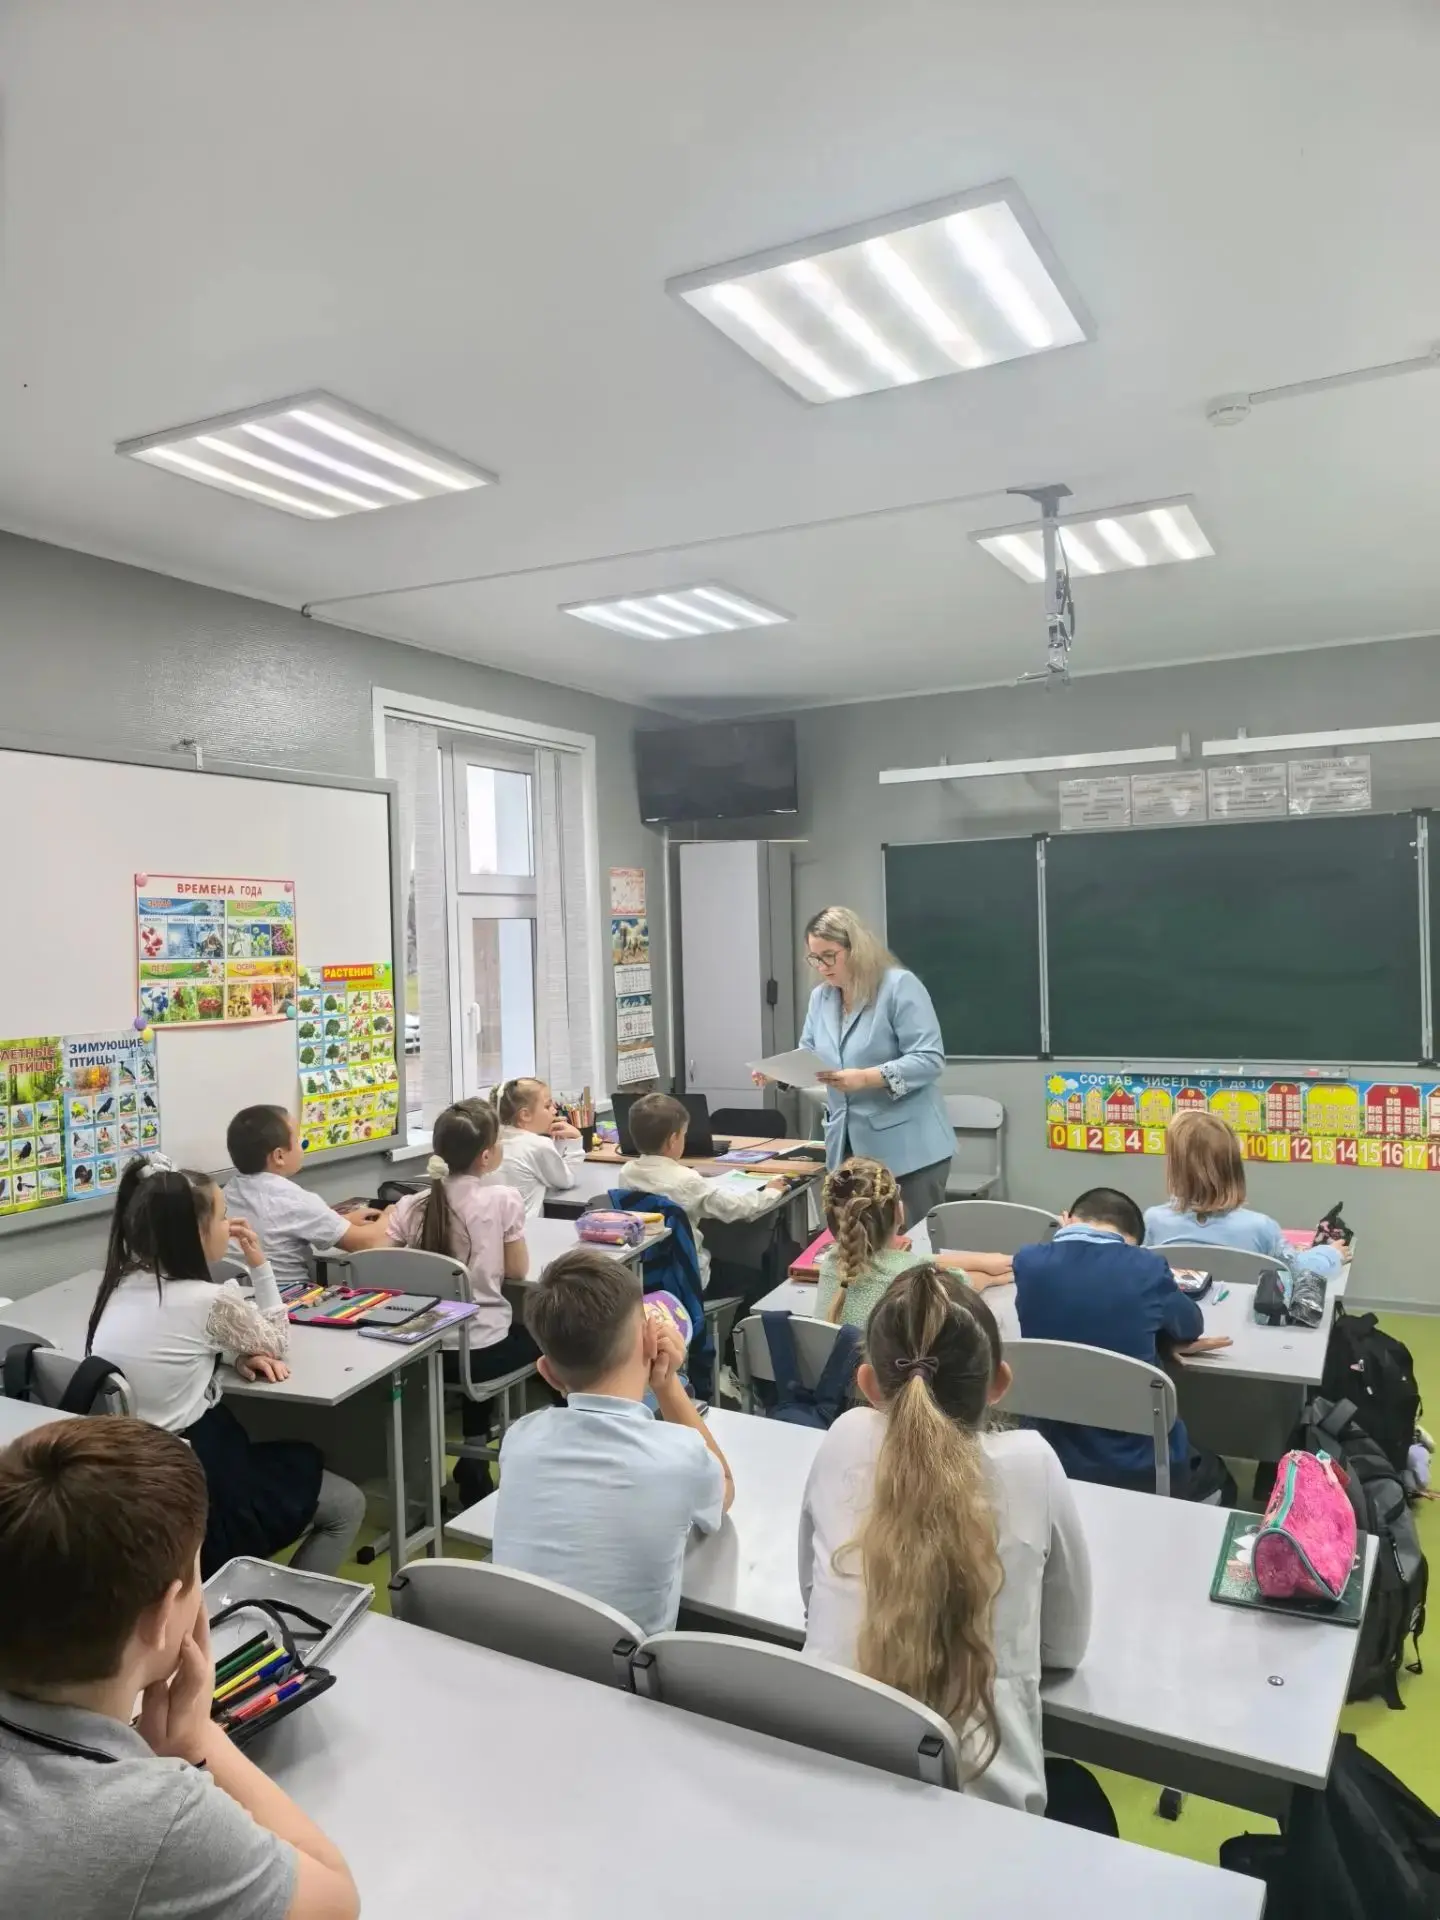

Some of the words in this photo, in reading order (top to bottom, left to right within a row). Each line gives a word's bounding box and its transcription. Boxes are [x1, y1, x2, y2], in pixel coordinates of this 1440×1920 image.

[177, 883, 234, 895] ВРЕМЕНА
[240, 885, 262, 898] ГОДА
[236, 963, 256, 971] ОСЕНЬ
[324, 967, 373, 978] РАСТЕНИЯ
[0, 1046, 55, 1060] ЛЕТНЫЕ
[69, 1038, 144, 1054] ЗИМУЮЩИЕ
[8, 1059, 57, 1074] ПТИЦЫ
[69, 1054, 116, 1068] ПТИЦЫ
[1080, 1074, 1133, 1086] СОСТАВ
[1143, 1076, 1189, 1087] ЧИСЕЛ
[1200, 1080, 1213, 1088] от
[1230, 1080, 1247, 1089] до
[1251, 1079, 1265, 1089] 10
[1053, 1125, 1065, 1146] 0
[1072, 1128, 1081, 1147] 1
[1088, 1128, 1103, 1149] 2
[1109, 1129, 1122, 1149] 3
[1126, 1130, 1141, 1150] 4
[1148, 1131, 1161, 1151] 5
[1247, 1135, 1267, 1157] 10
[1271, 1138, 1287, 1160] 11
[1291, 1138, 1312, 1160] 12
[1315, 1140, 1335, 1161] 13
[1337, 1140, 1357, 1162] 14
[1361, 1142, 1381, 1162] 15
[1383, 1142, 1403, 1165] 16
[1405, 1145, 1426, 1165] 17
